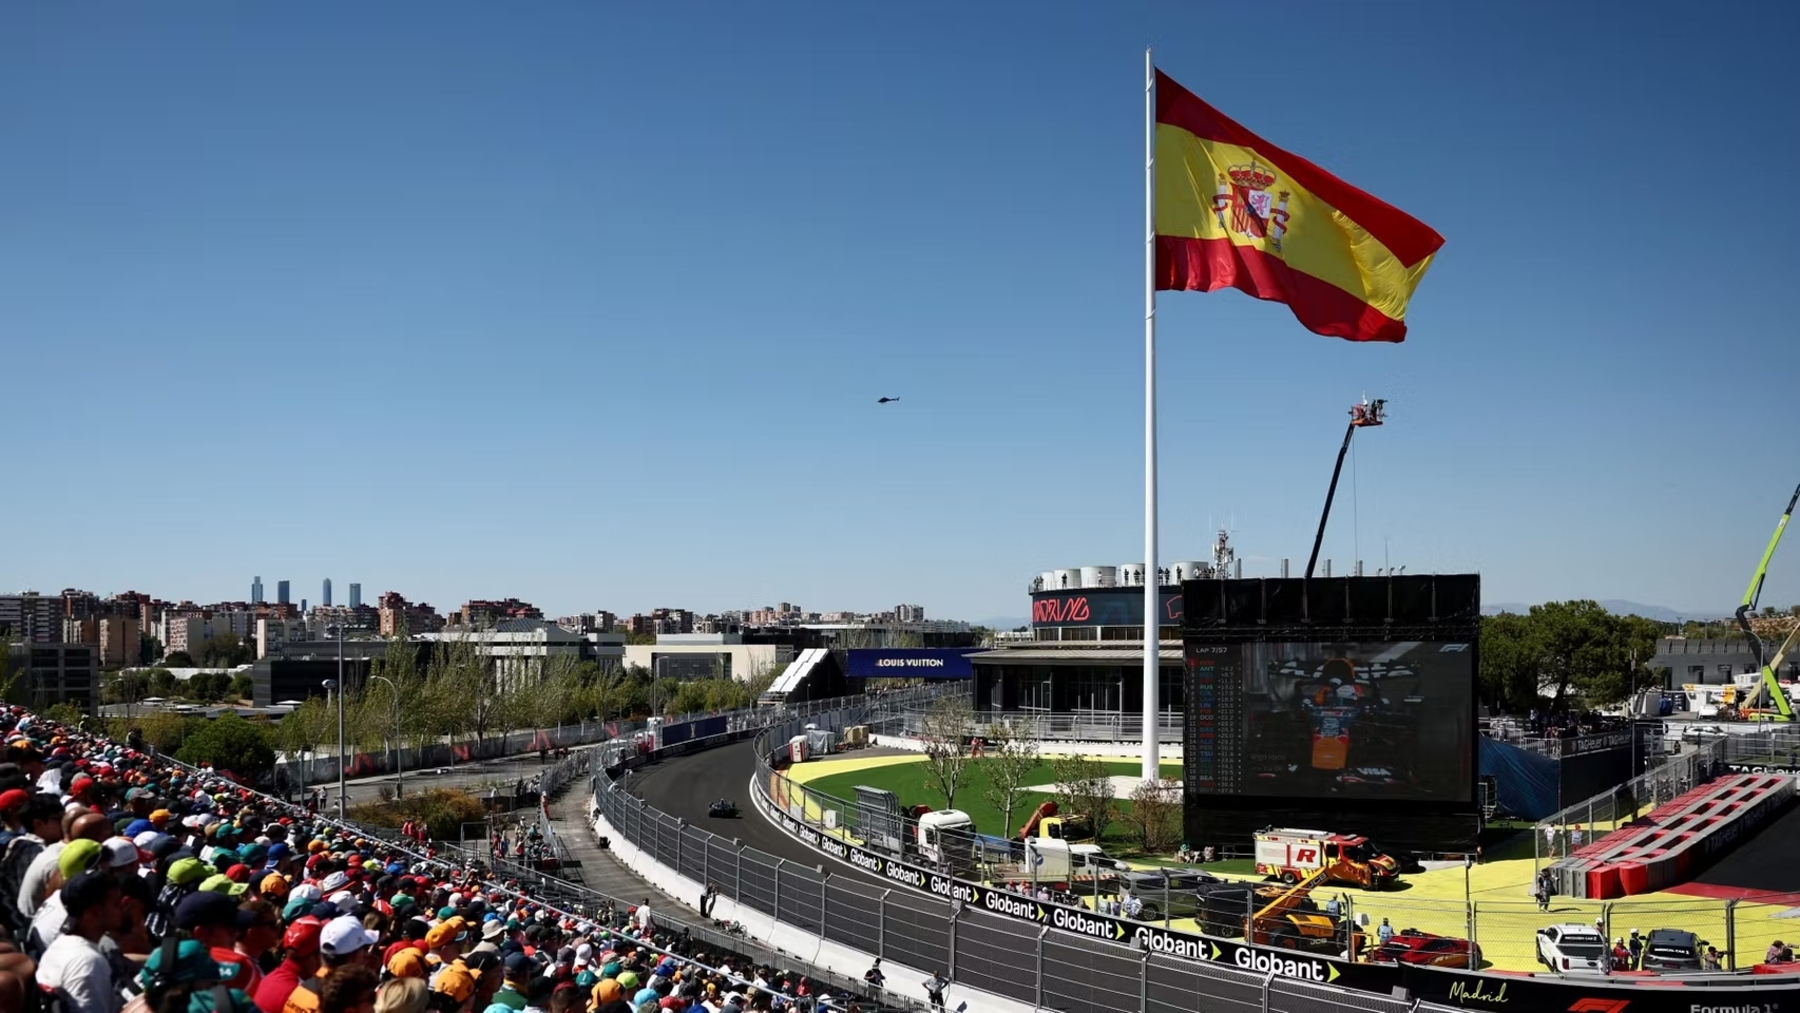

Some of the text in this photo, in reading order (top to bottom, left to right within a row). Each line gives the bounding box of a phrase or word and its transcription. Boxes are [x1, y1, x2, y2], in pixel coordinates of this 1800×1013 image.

[879, 658, 944, 667] LOUIS VUITTON
[800, 826, 817, 844] Globant
[822, 836, 844, 856] Globant
[1297, 849, 1316, 862] R
[850, 848, 877, 871] Globant
[886, 862, 920, 886] Globant
[1308, 872, 1326, 888] JCB
[985, 891, 1036, 920] Globant
[1053, 908, 1114, 939] Globant
[1136, 927, 1208, 960] Globant
[219, 968, 232, 976] 14
[1234, 948, 1324, 982] Globant
[1449, 979, 1508, 1004] Madrid
[1690, 1004, 1760, 1013] Formula
